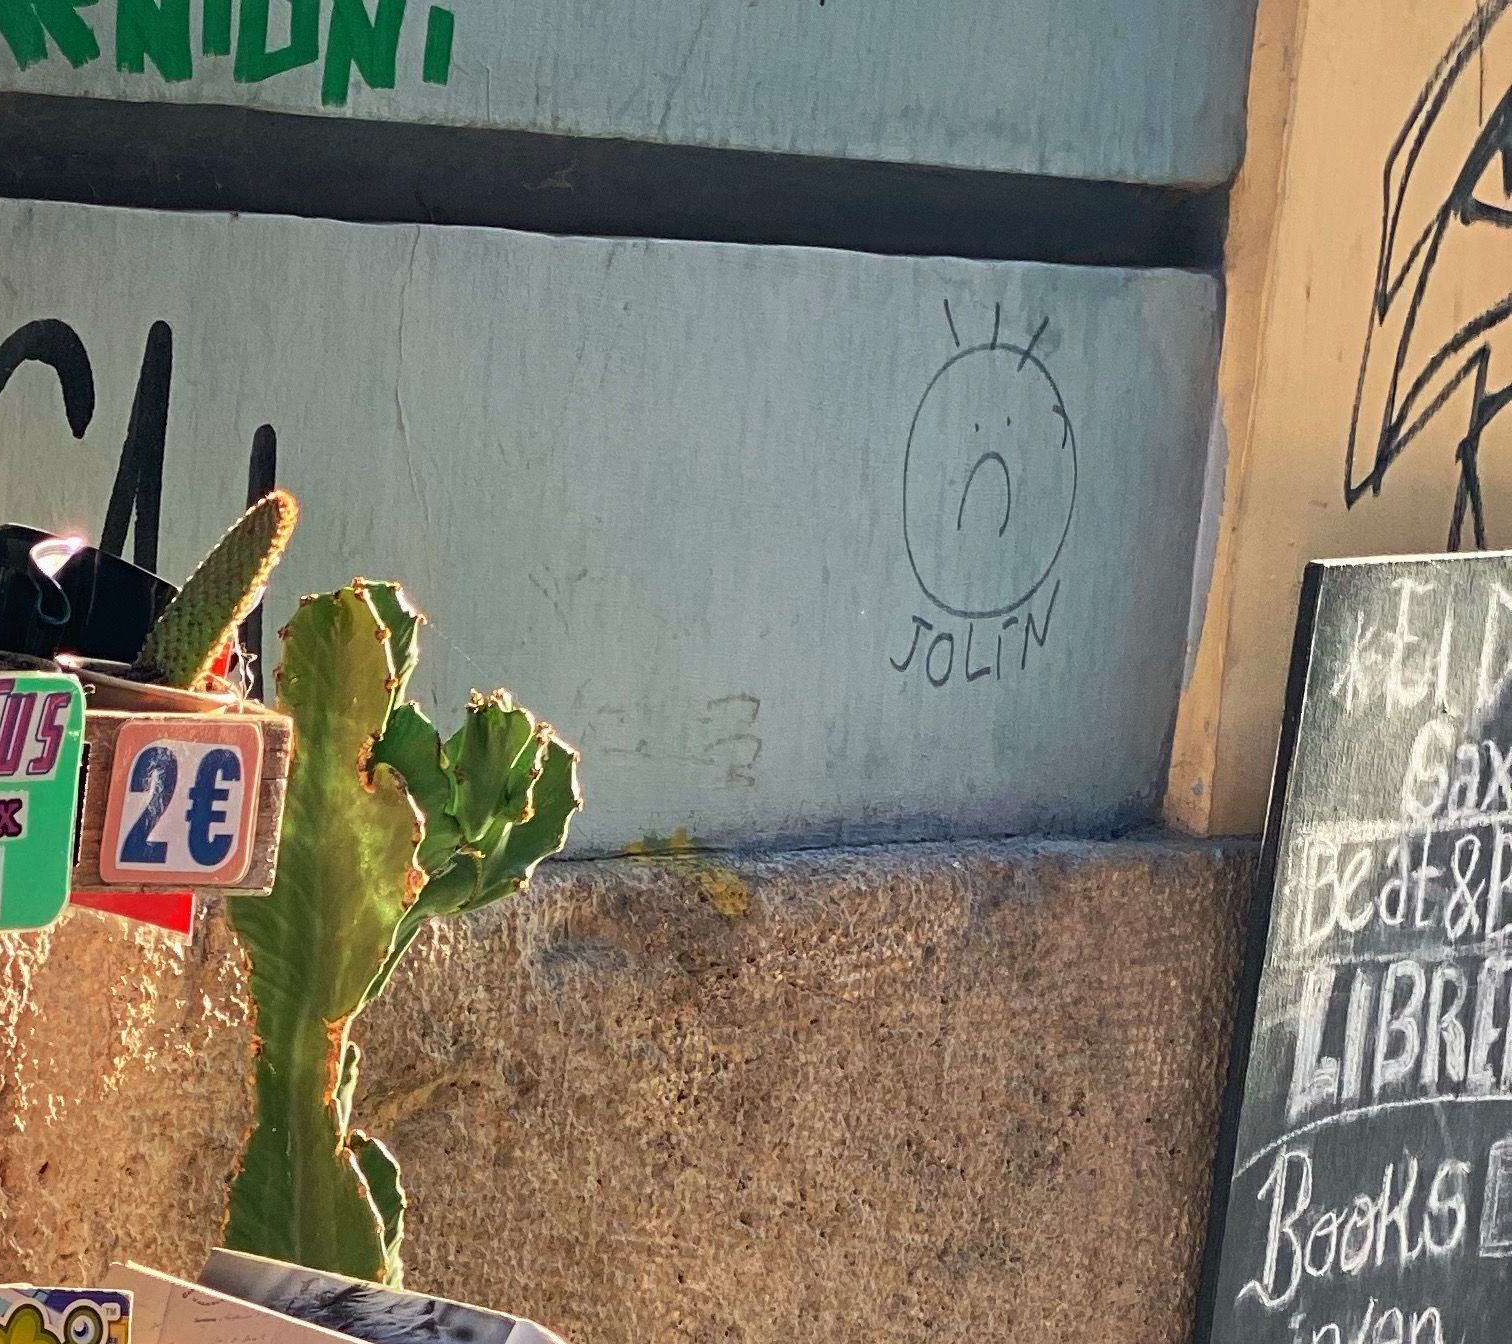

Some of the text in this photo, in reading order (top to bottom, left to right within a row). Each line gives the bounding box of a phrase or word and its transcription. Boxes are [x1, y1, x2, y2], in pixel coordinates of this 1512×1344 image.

[118, 741, 242, 869] 2€
[1284, 956, 1512, 1126] LIBRE
[1236, 1140, 1472, 1309] Books
